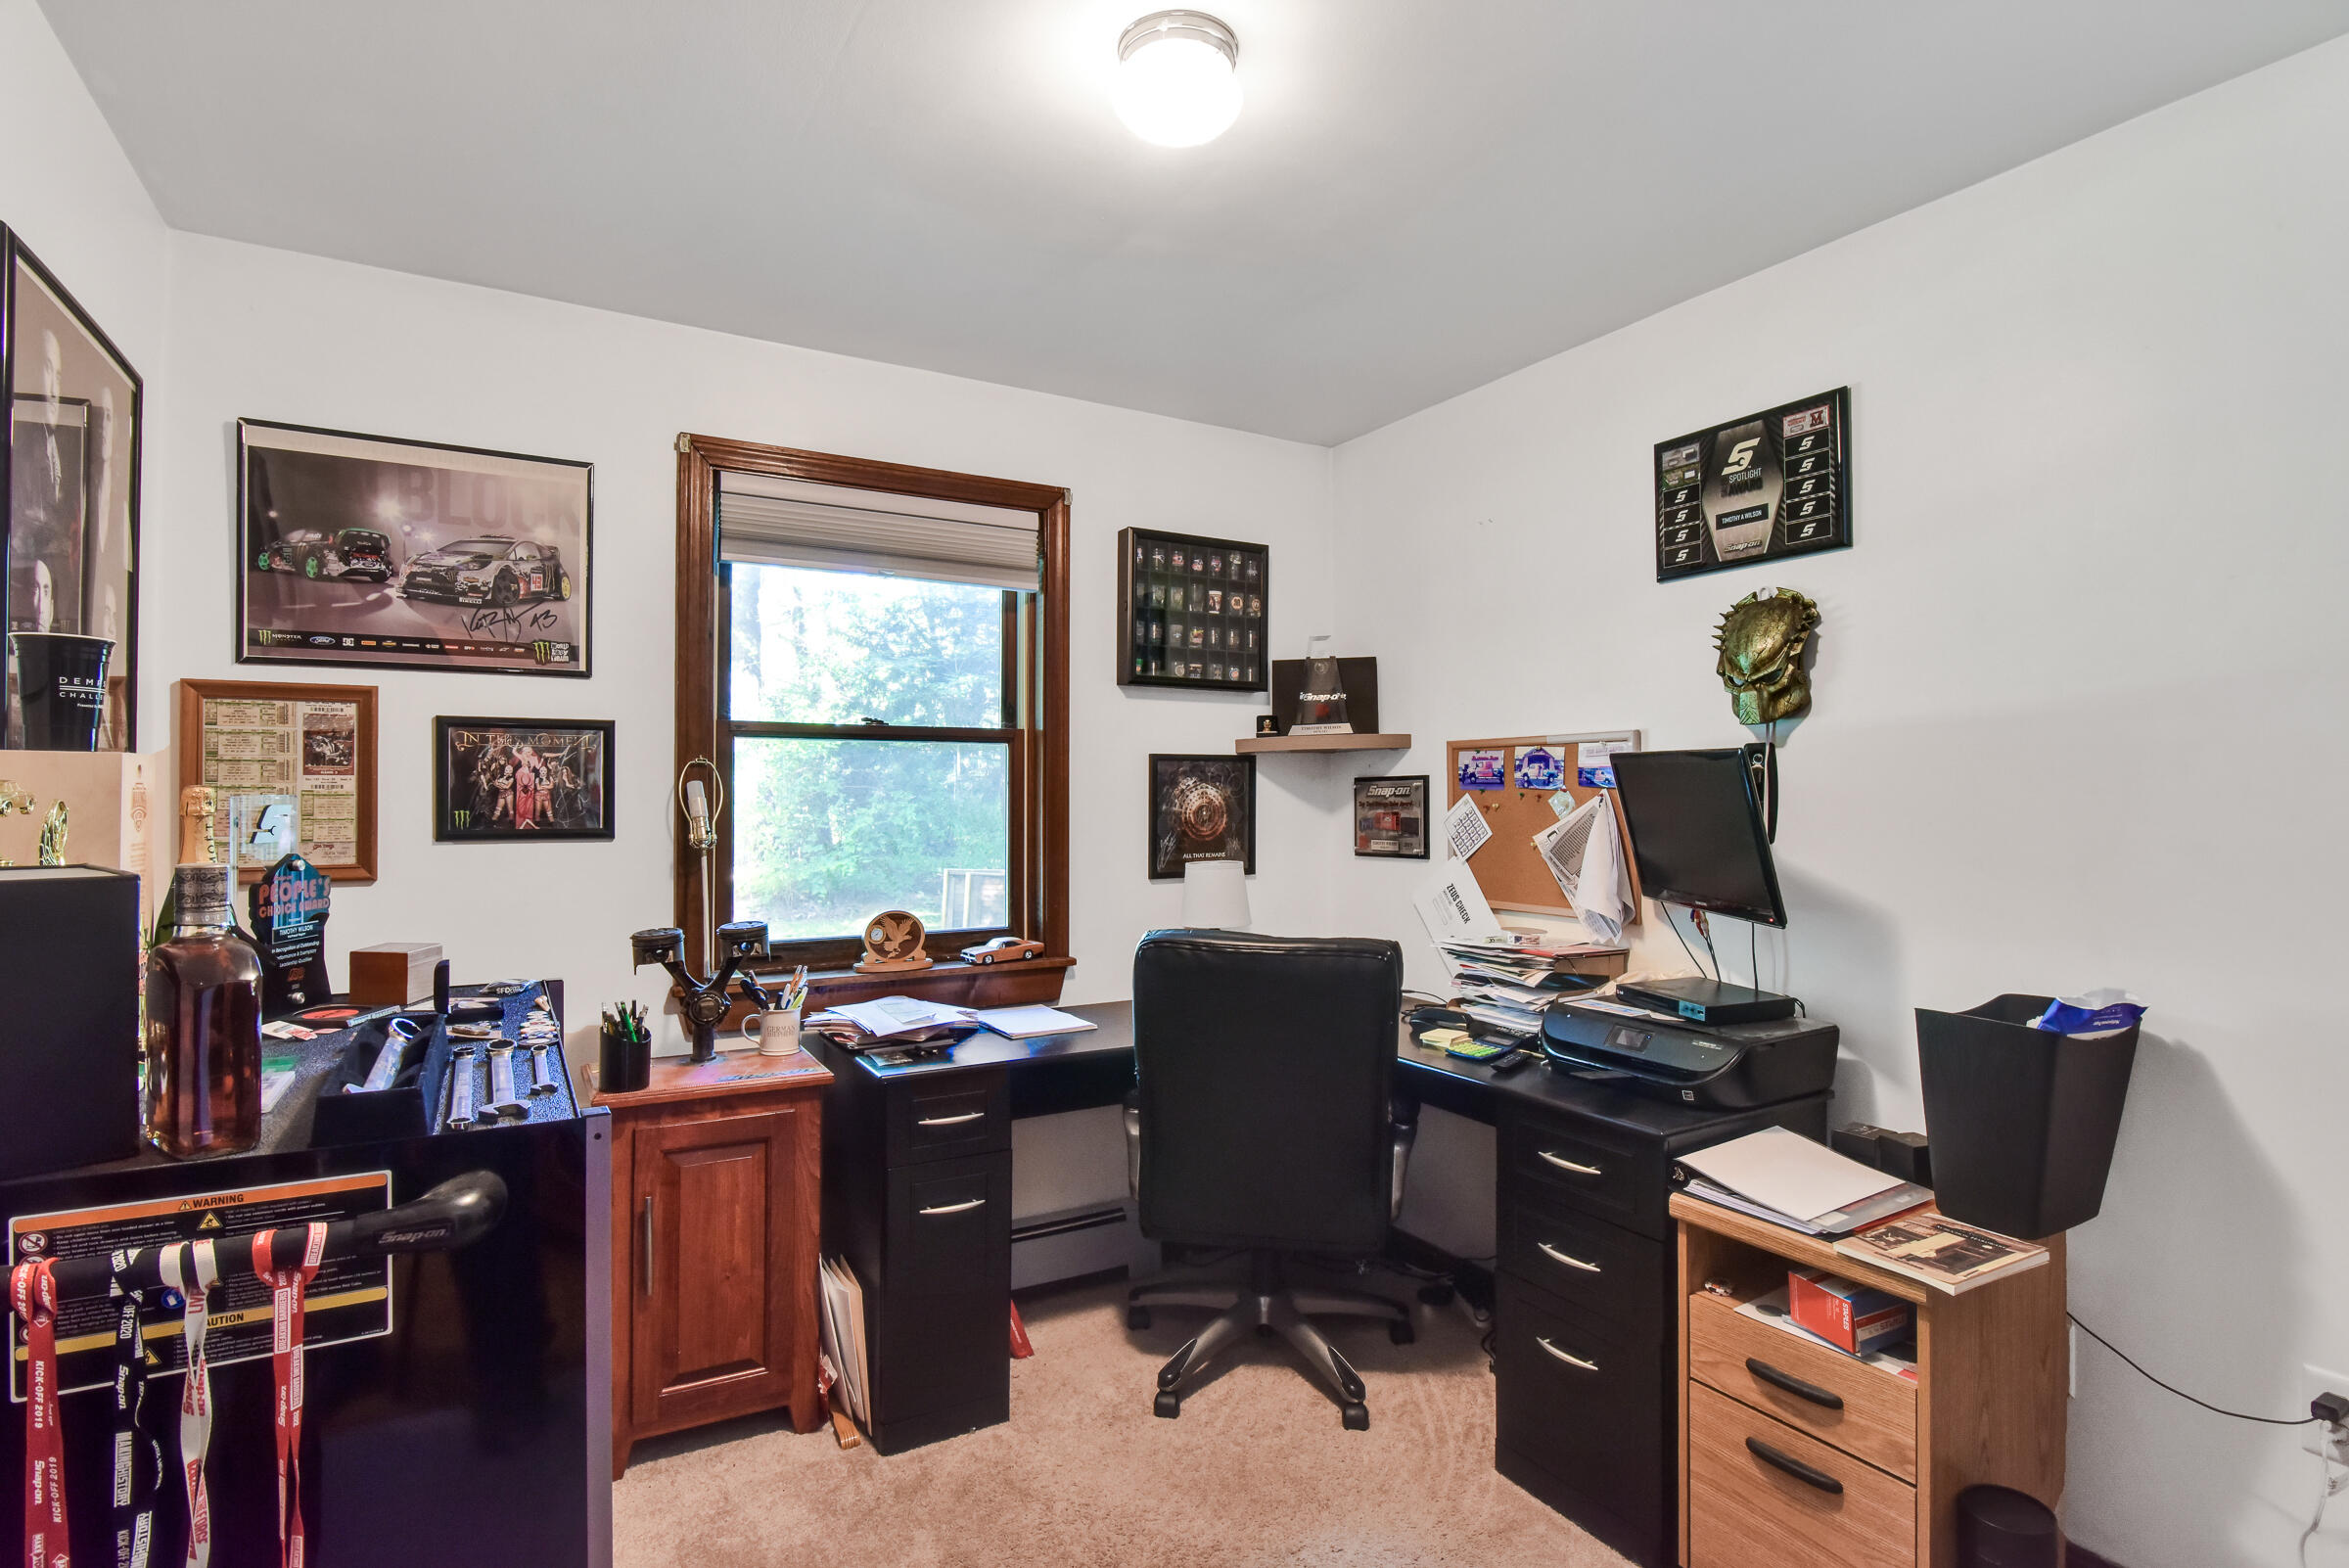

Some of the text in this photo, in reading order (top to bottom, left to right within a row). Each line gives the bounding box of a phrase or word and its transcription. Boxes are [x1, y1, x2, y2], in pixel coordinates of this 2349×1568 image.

[1728, 468, 1762, 484] SPOTLIGHT
[1722, 514, 1740, 525] TIMOTHY
[1744, 510, 1762, 520] WILSON
[1366, 785, 1411, 798] Snap-on
[258, 877, 331, 905] PEOPLE'S
[258, 898, 330, 918] CHOICE AWARD
[1447, 883, 1471, 924] ZEUS CHECK
[279, 924, 313, 936] TIMOTHY WILSON
[193, 1194, 244, 1209] WARNING
[378, 1228, 447, 1244] Snap-on
[119, 1320, 134, 1339] 2020
[207, 1313, 244, 1328] AUTION
[277, 1291, 289, 1352] BREAKING BARRIERS
[34, 1360, 45, 1429] KICK-OFF 2019
[50, 1481, 62, 1523] KICK-OFF
[116, 1529, 130, 1559] KICK-OFF
